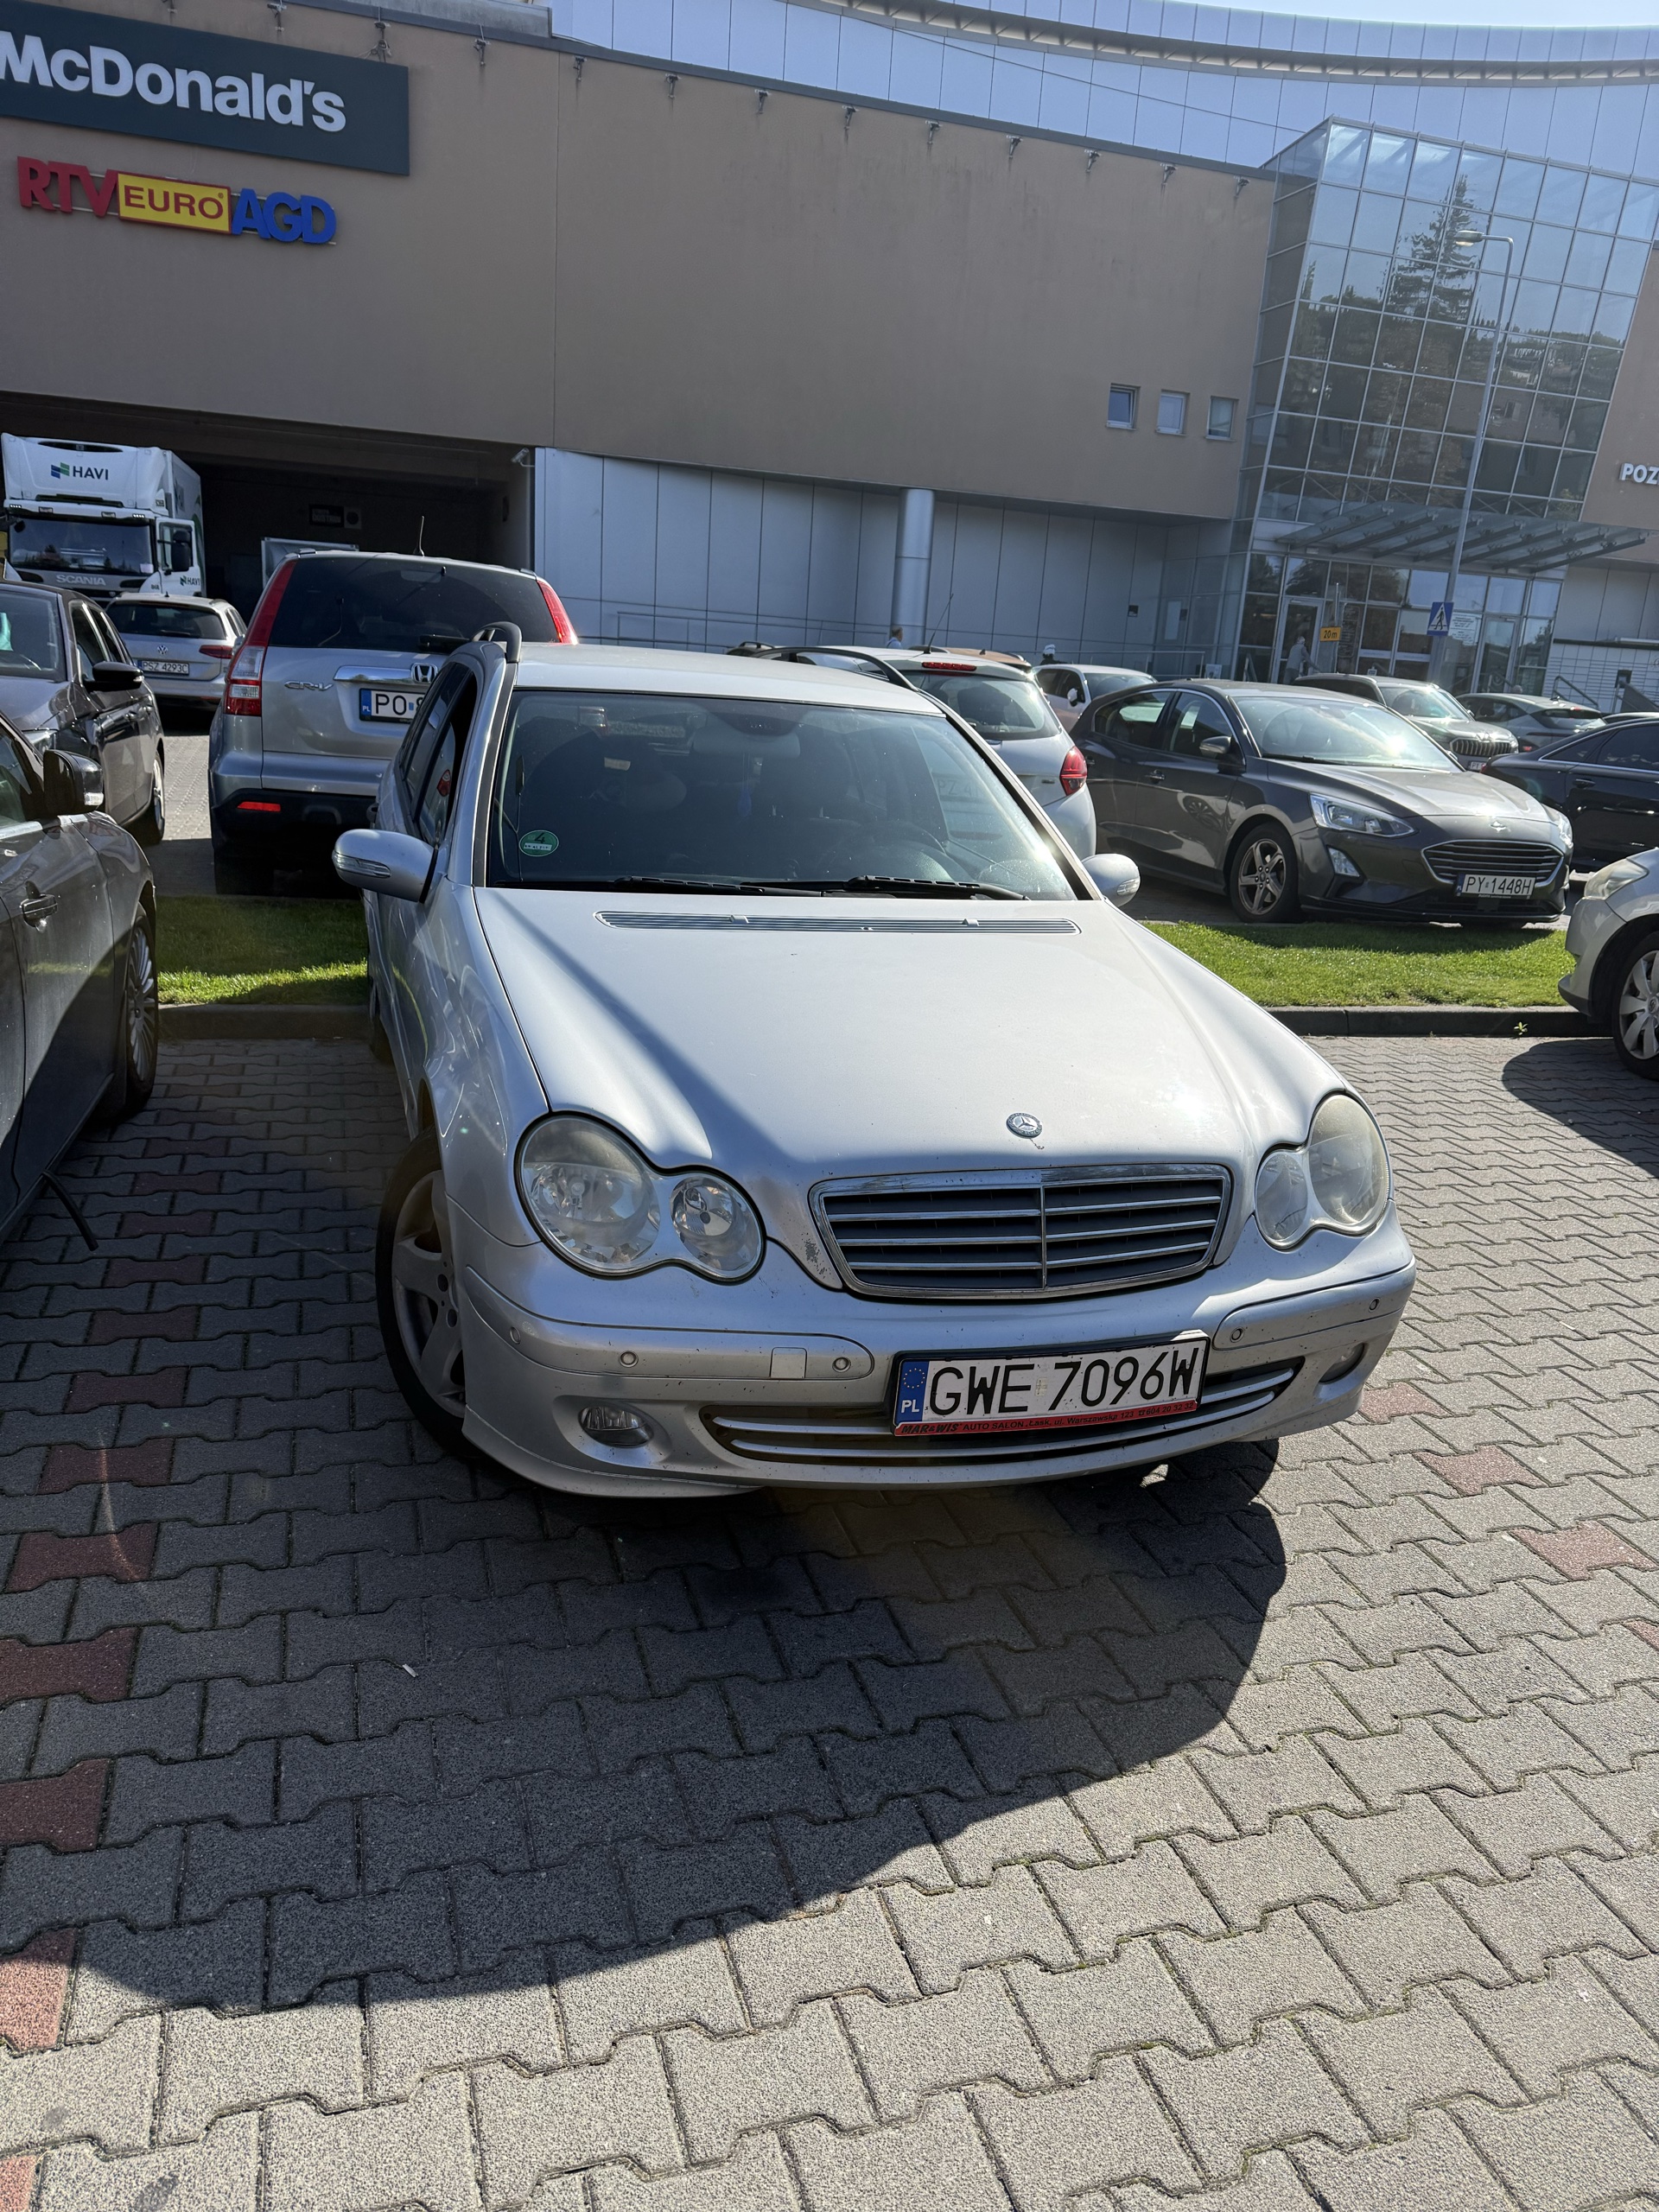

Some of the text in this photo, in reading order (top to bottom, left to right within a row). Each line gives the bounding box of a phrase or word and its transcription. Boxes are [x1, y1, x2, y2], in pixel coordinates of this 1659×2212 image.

[0, 31, 346, 132] McDonald's
[17, 156, 118, 218] RTV
[232, 188, 337, 244] AGD
[73, 466, 109, 480] HAVI
[55, 574, 106, 586] SCANIA
[187, 576, 200, 586] HAVI
[534, 832, 546, 843] 4
[1465, 876, 1532, 894] PY 1448H
[929, 1347, 1199, 1416] GWE 7096W
[901, 1400, 920, 1414] PL
[963, 1423, 988, 1432] AUTO
